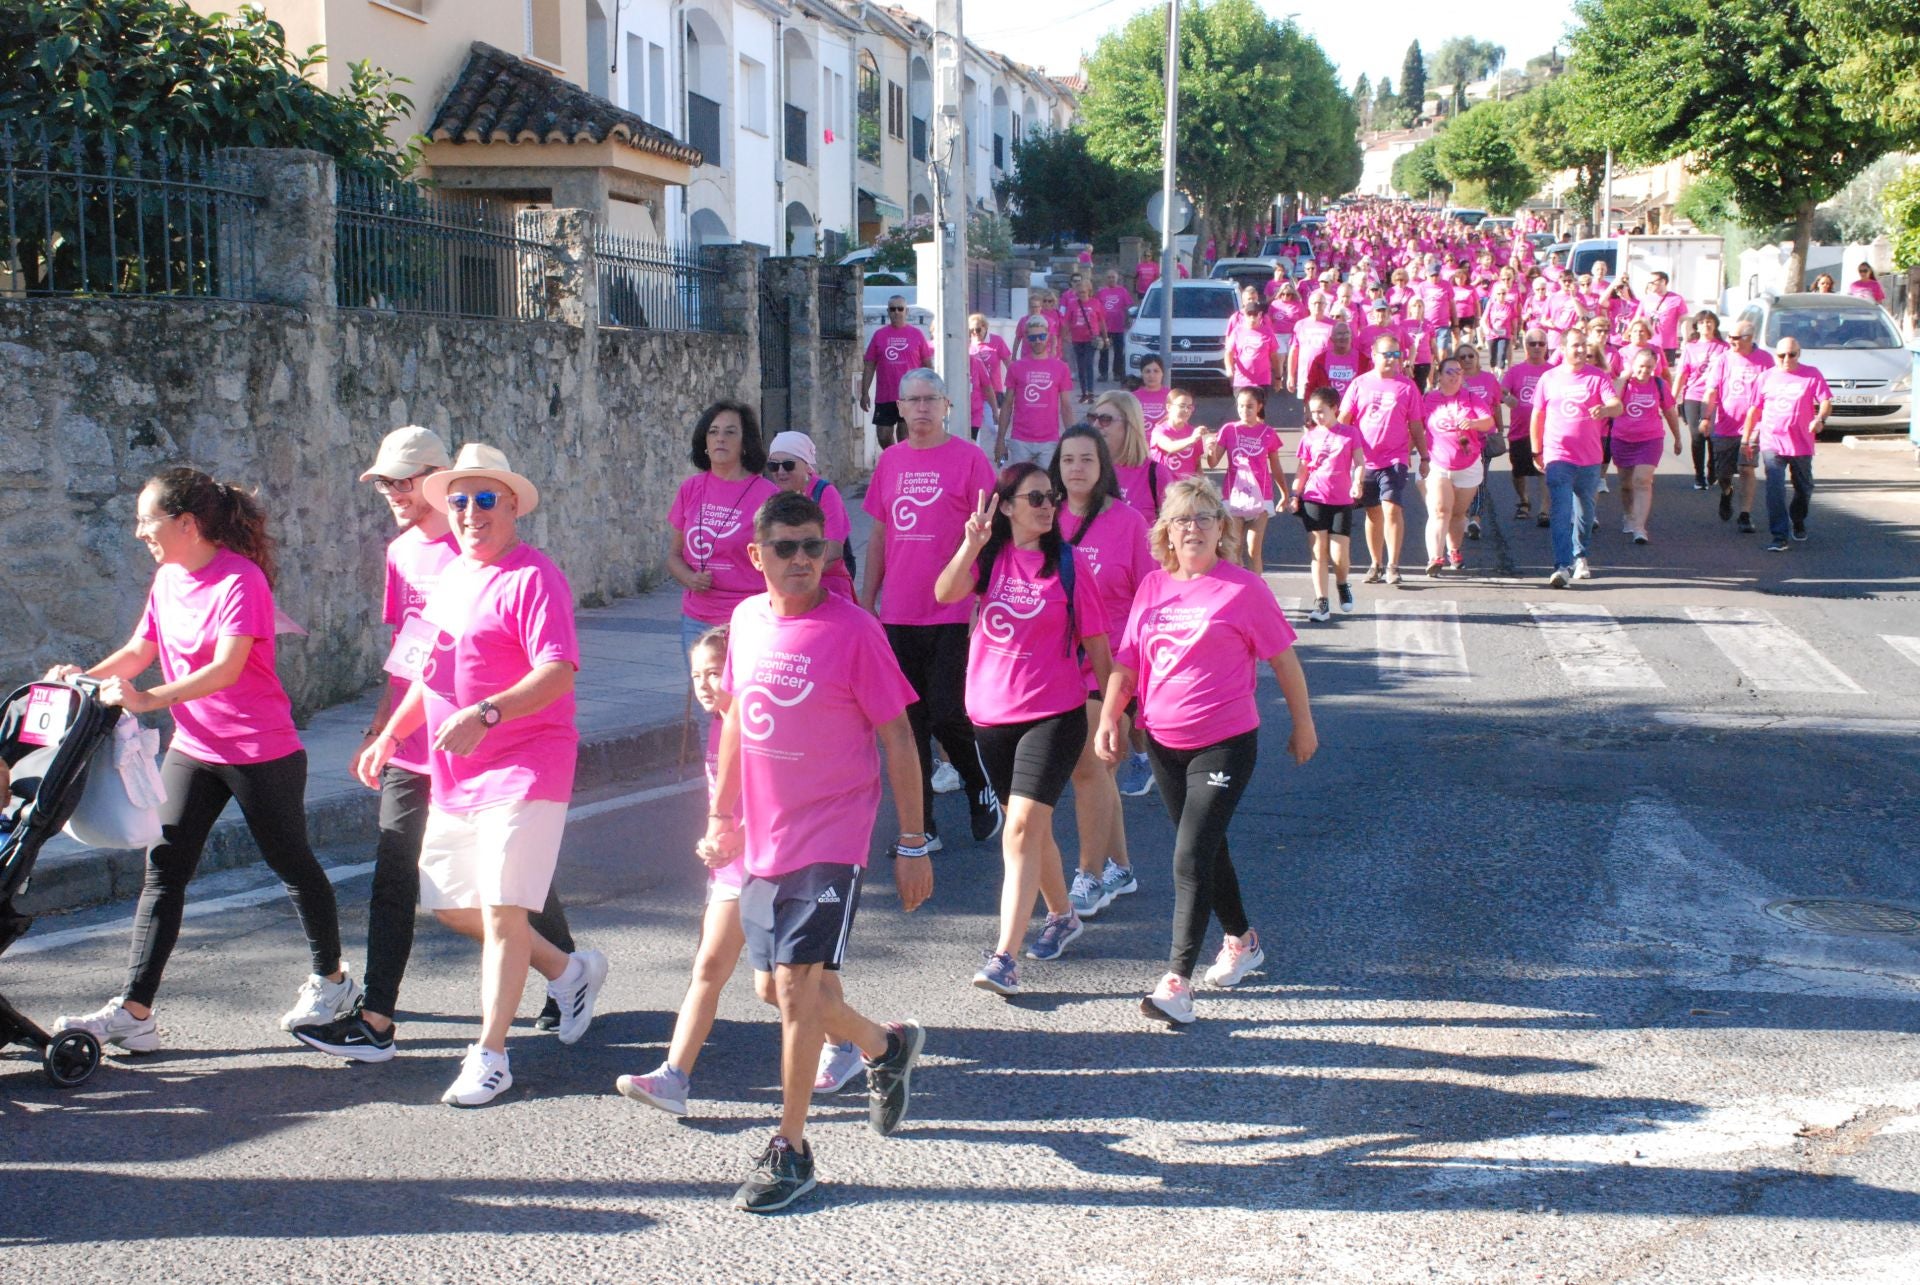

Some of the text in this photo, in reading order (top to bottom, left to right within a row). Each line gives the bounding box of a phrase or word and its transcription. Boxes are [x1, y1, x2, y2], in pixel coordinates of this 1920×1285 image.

[902, 484, 938, 494] cáncer
[704, 510, 729, 519] contra
[731, 512, 739, 520] el
[716, 505, 742, 515] marcha
[702, 517, 736, 528] cáncer
[1006, 577, 1016, 585] En
[1004, 585, 1030, 594] contra
[1000, 592, 1040, 606] cáncer
[774, 650, 812, 664] marcha
[796, 664, 808, 674] el
[755, 670, 806, 689] cáncer
[39, 712, 51, 730] 0
